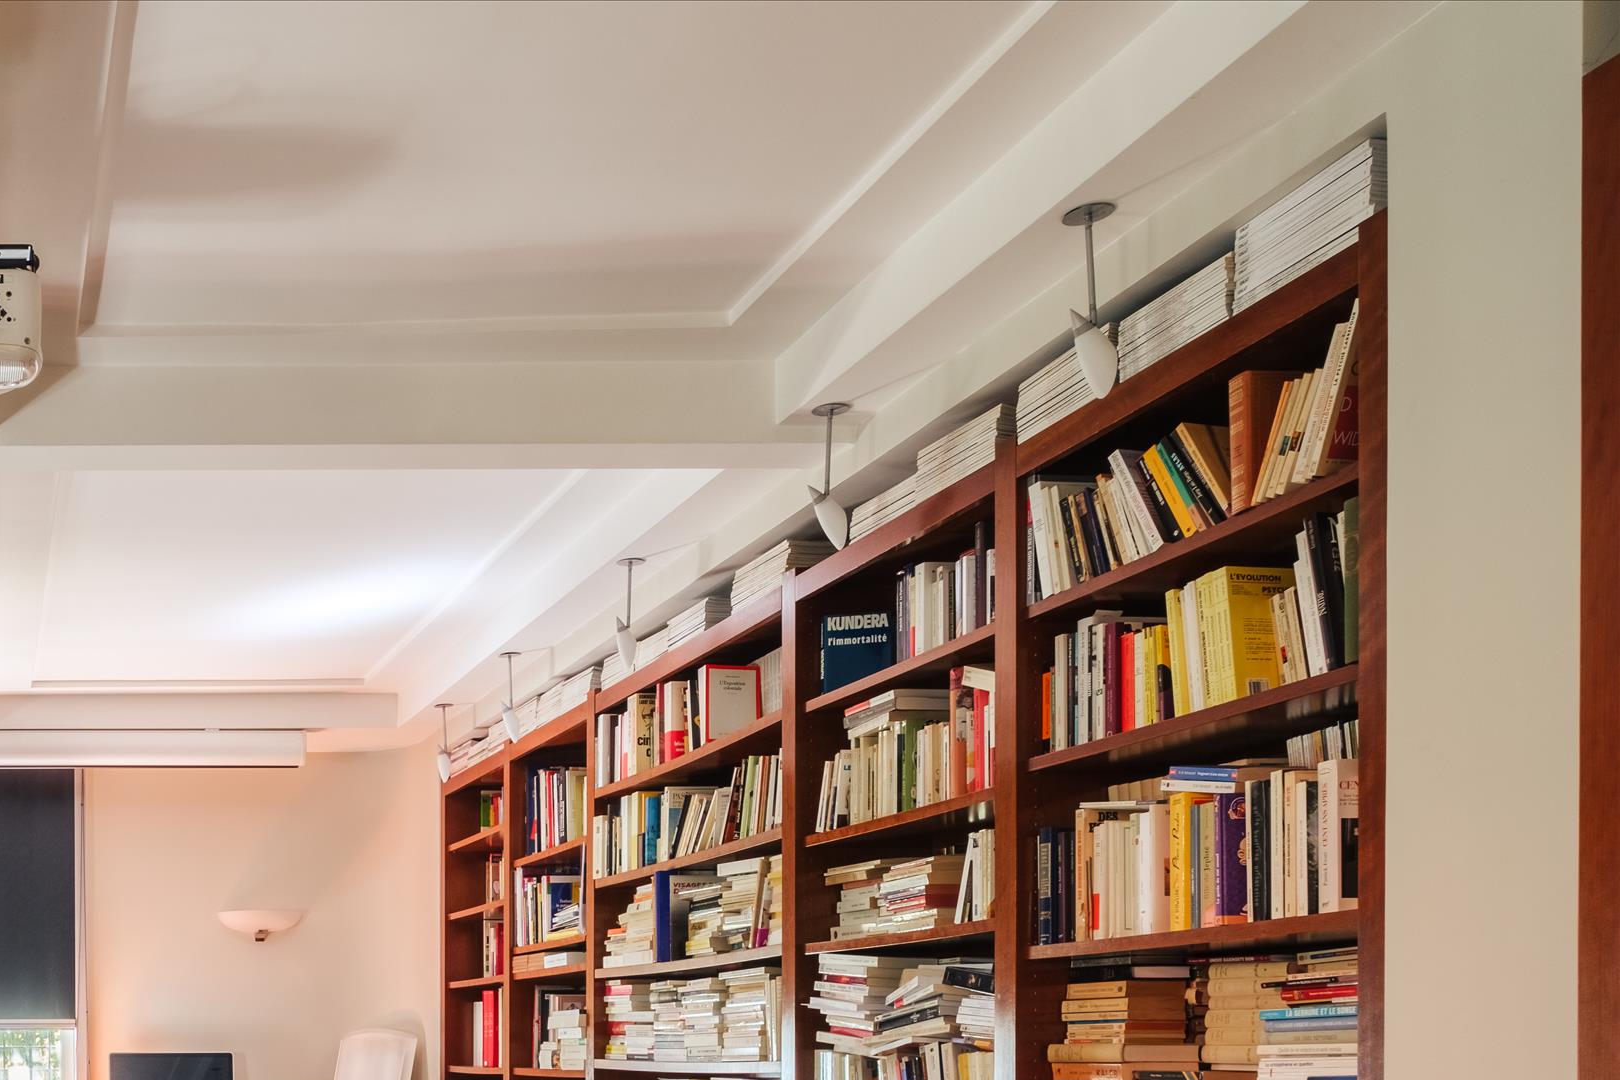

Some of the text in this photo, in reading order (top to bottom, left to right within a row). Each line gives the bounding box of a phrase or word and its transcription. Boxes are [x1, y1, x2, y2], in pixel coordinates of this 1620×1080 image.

[1170, 452, 1184, 471] ATLAS
[828, 613, 889, 631] KUNDERA
[828, 634, 887, 646] l'immortalité
[1098, 812, 1118, 820] DES
[1320, 1007, 1328, 1015] ET
[1329, 1007, 1336, 1015] LE
[1096, 1069, 1118, 1078] KALEB
